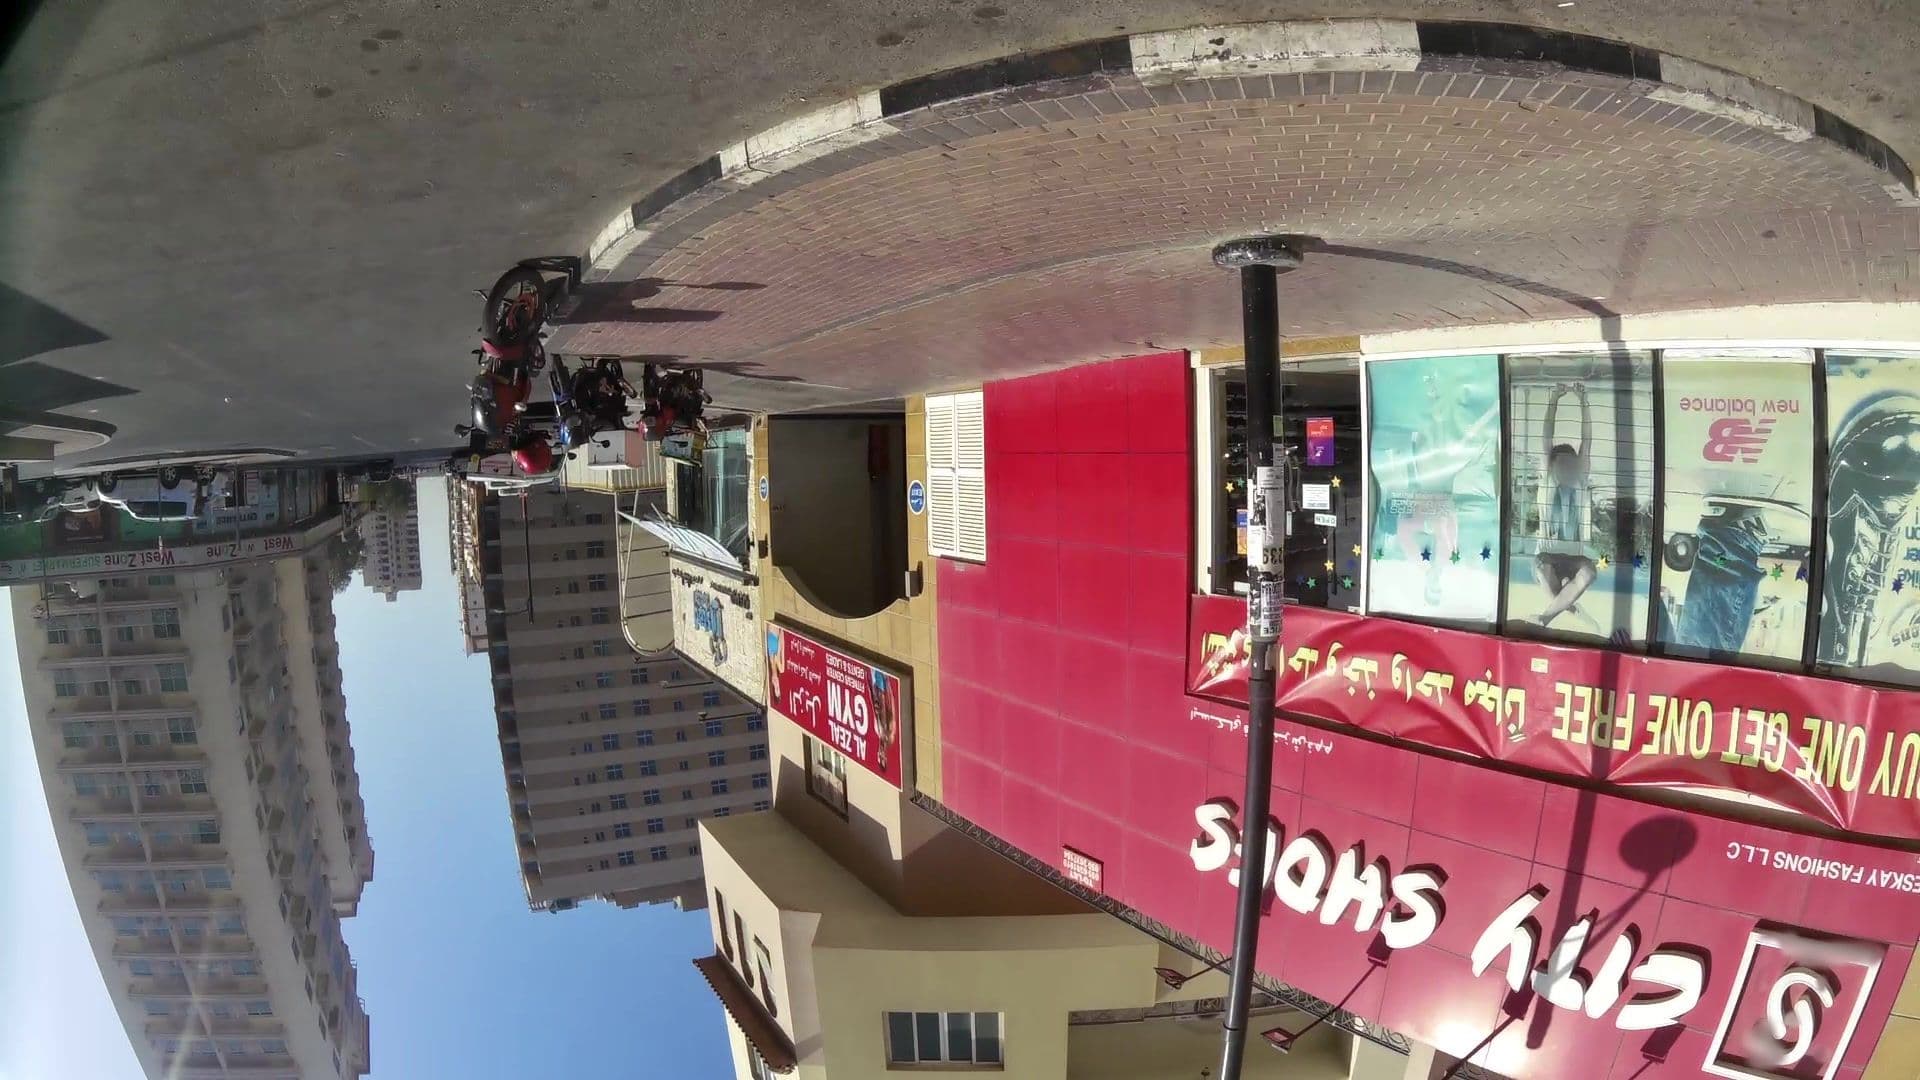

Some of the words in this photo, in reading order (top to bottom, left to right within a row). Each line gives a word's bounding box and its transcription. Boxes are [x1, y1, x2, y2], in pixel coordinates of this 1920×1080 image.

[1679, 397, 1756, 416] balance
[1760, 398, 1800, 414] new
[1315, 516, 1335, 524] OPEN
[264, 536, 294, 552] West
[104, 554, 136, 568] Zone
[140, 550, 174, 566] West
[826, 652, 842, 670] LADIES
[846, 662, 865, 680] GENTS
[826, 665, 844, 684] CENTER
[1279, 644, 1320, 681] احد
[1391, 653, 1454, 707] واحد
[826, 679, 868, 736] GYM
[1551, 681, 1636, 751] FREE
[828, 720, 852, 753] ZEAL
[1641, 694, 1713, 760] ONE
[1720, 707, 1789, 772] GET
[853, 734, 866, 761] AL
[1795, 716, 1866, 791] ONE
[1868, 731, 1920, 800] UY
[1726, 842, 1770, 865] L.L.C
[1773, 851, 1864, 883] FASHIONS
[1866, 868, 1920, 894] ESKAY
[1470, 887, 1706, 1030] CITY
